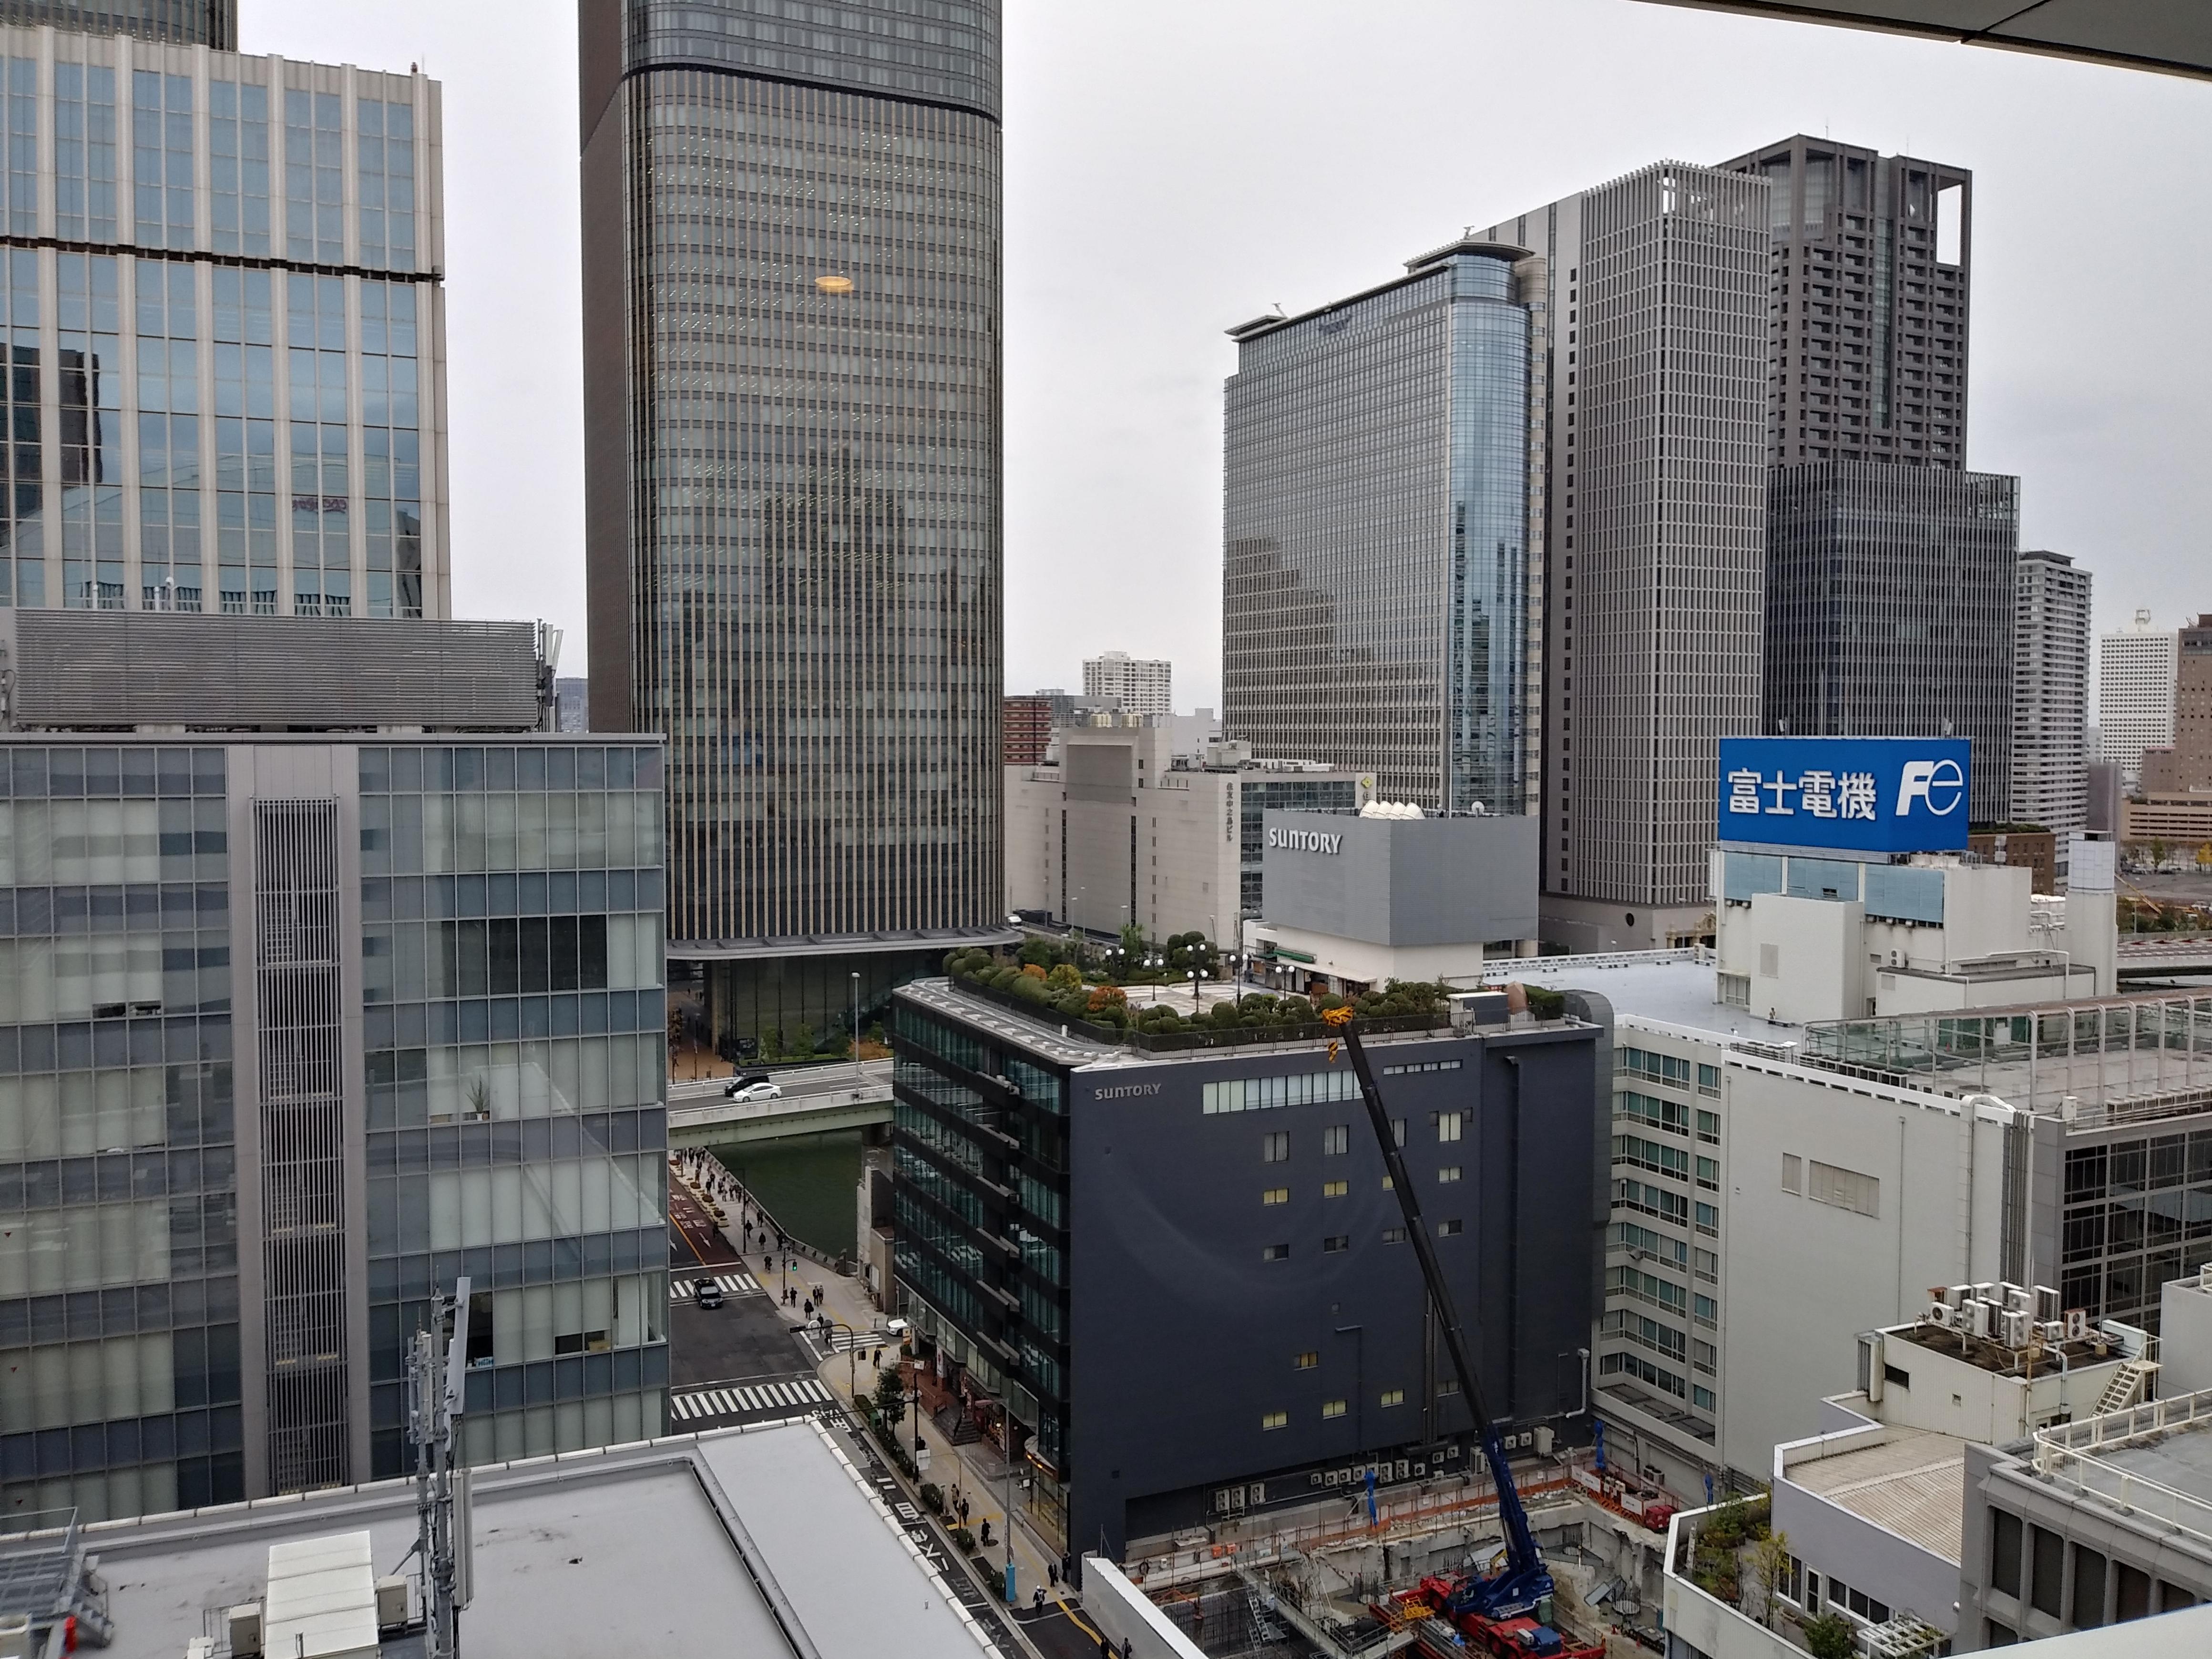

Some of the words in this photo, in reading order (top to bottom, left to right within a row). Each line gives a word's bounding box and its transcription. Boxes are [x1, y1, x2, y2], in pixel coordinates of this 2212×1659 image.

[1728, 767, 1876, 820] 富士電機
[1895, 759, 1964, 816] Fe
